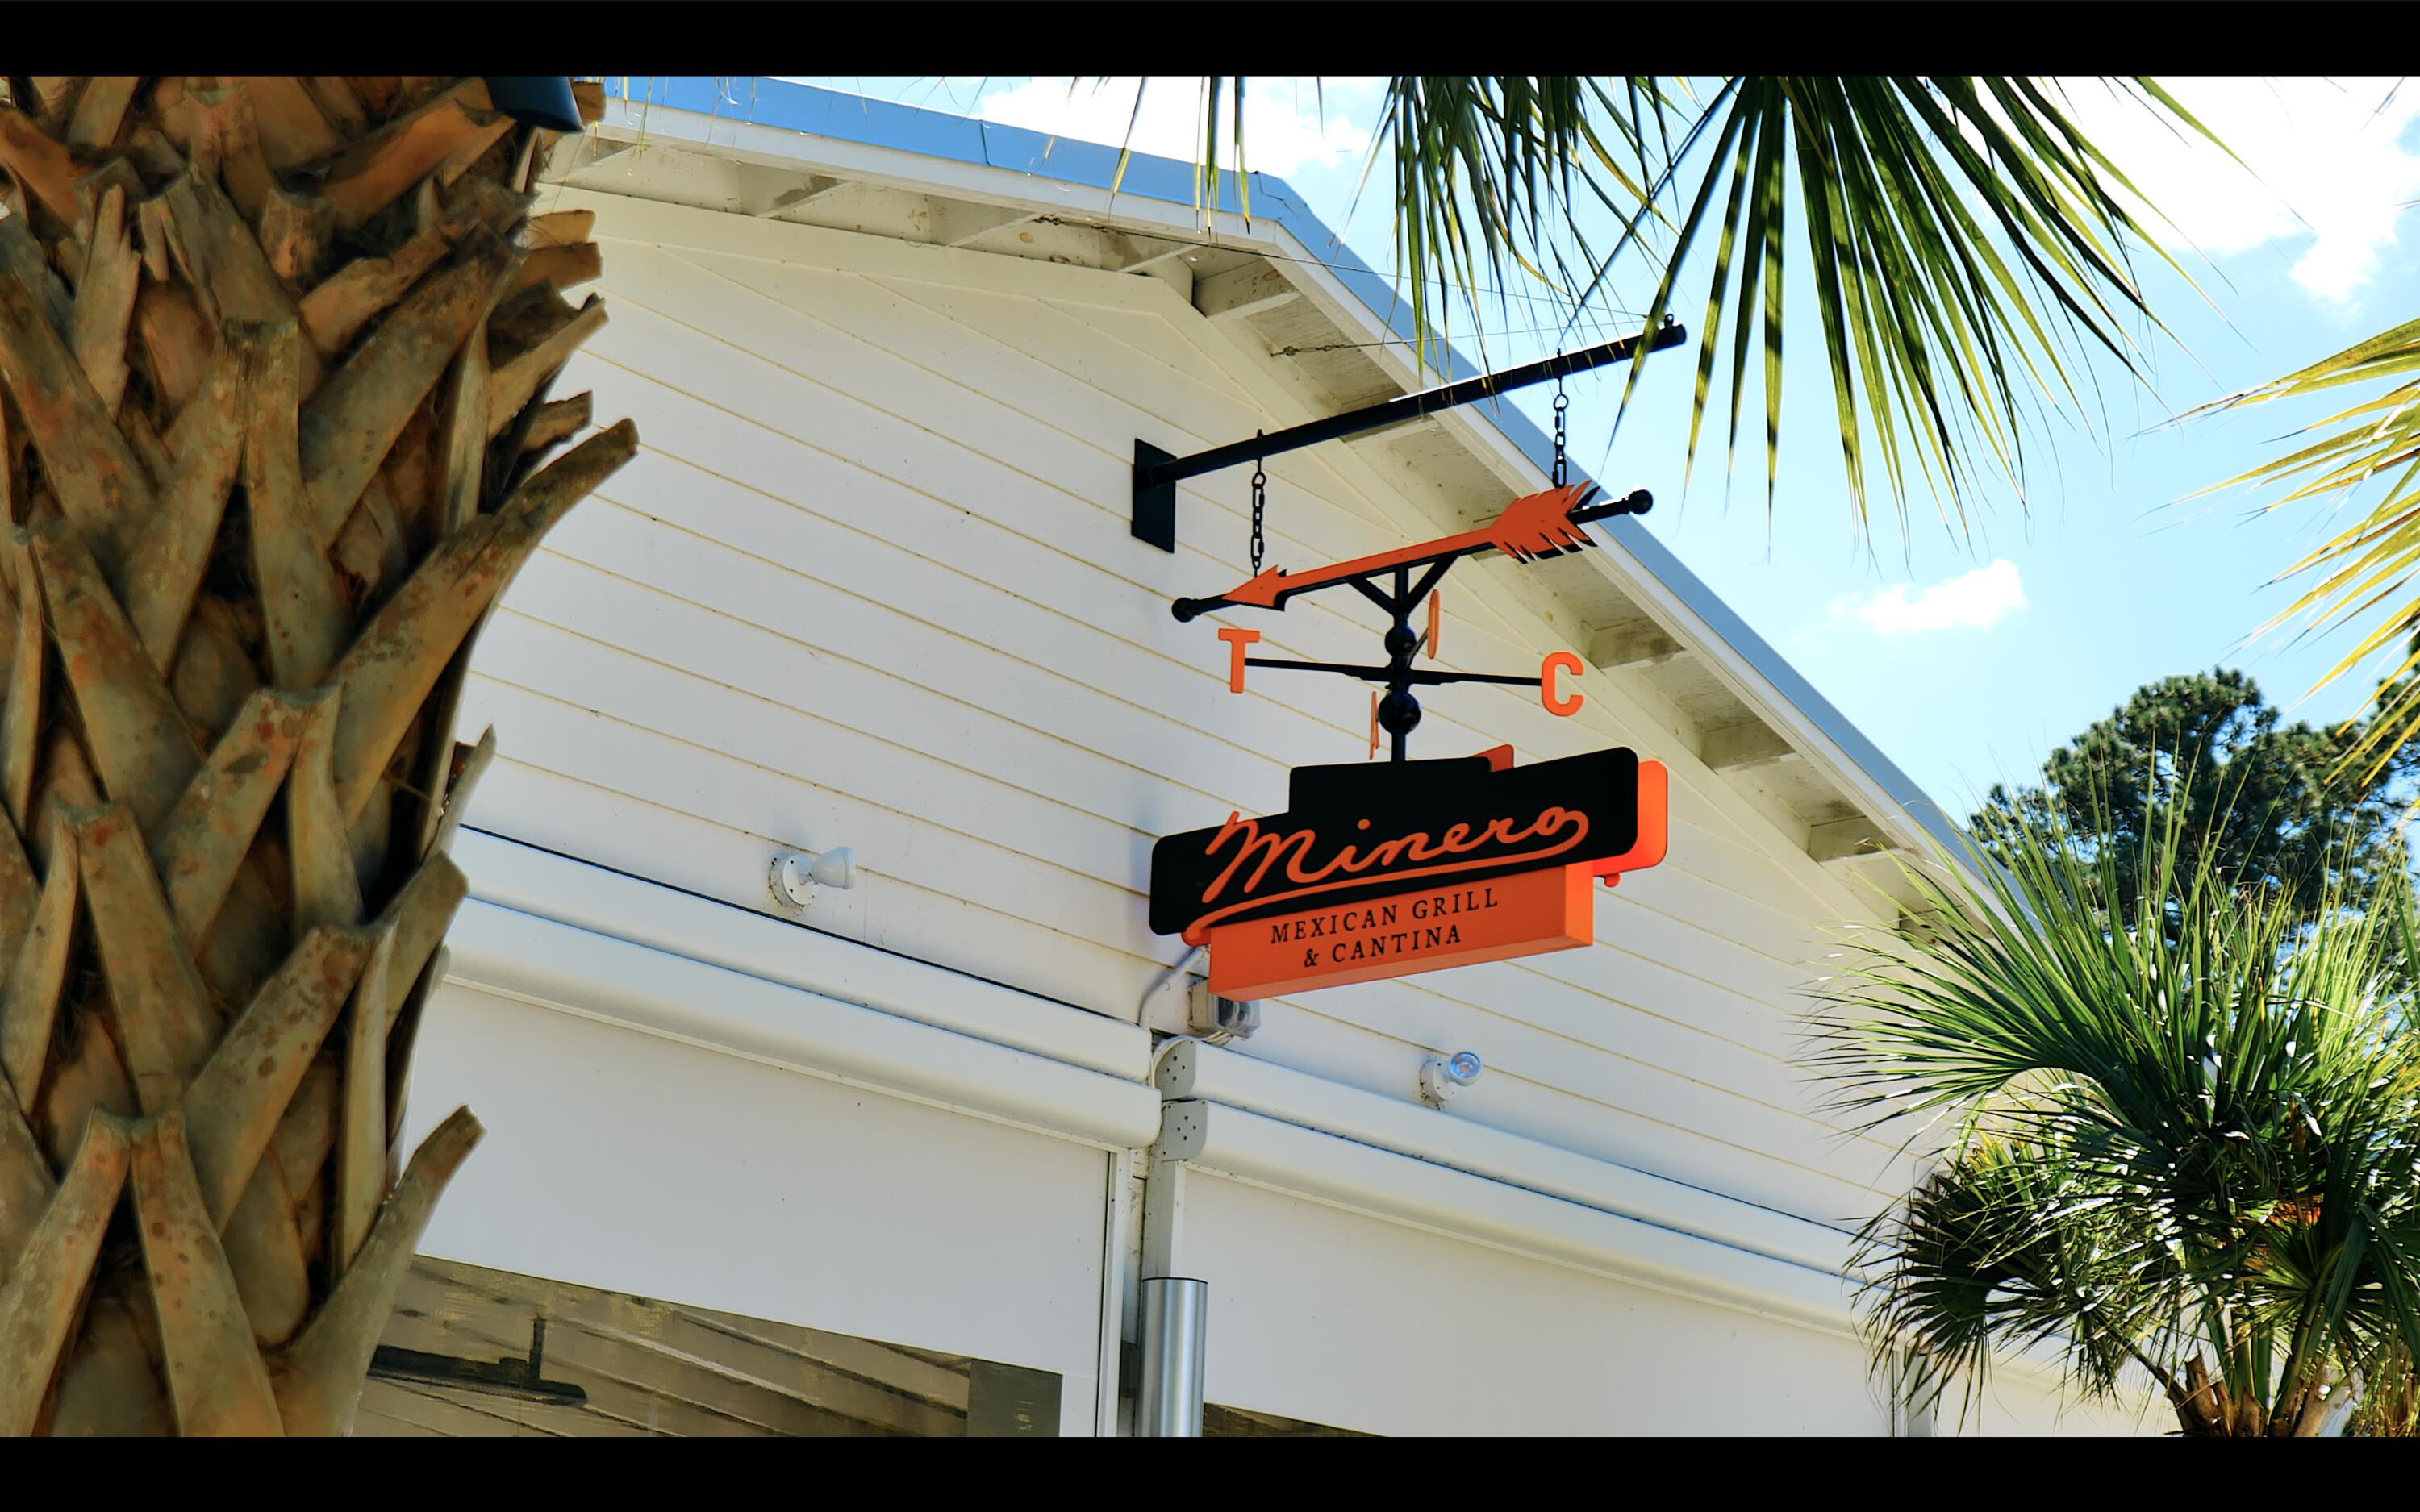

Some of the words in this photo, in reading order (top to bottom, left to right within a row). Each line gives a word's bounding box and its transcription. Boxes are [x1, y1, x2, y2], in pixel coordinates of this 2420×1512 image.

[1218, 628, 1260, 693] T
[1541, 652, 1584, 716] C
[1270, 904, 1398, 944] MEXICAN
[1412, 887, 1499, 920] GRILL
[1304, 948, 1320, 968] &
[1332, 924, 1462, 963] CANTINA
